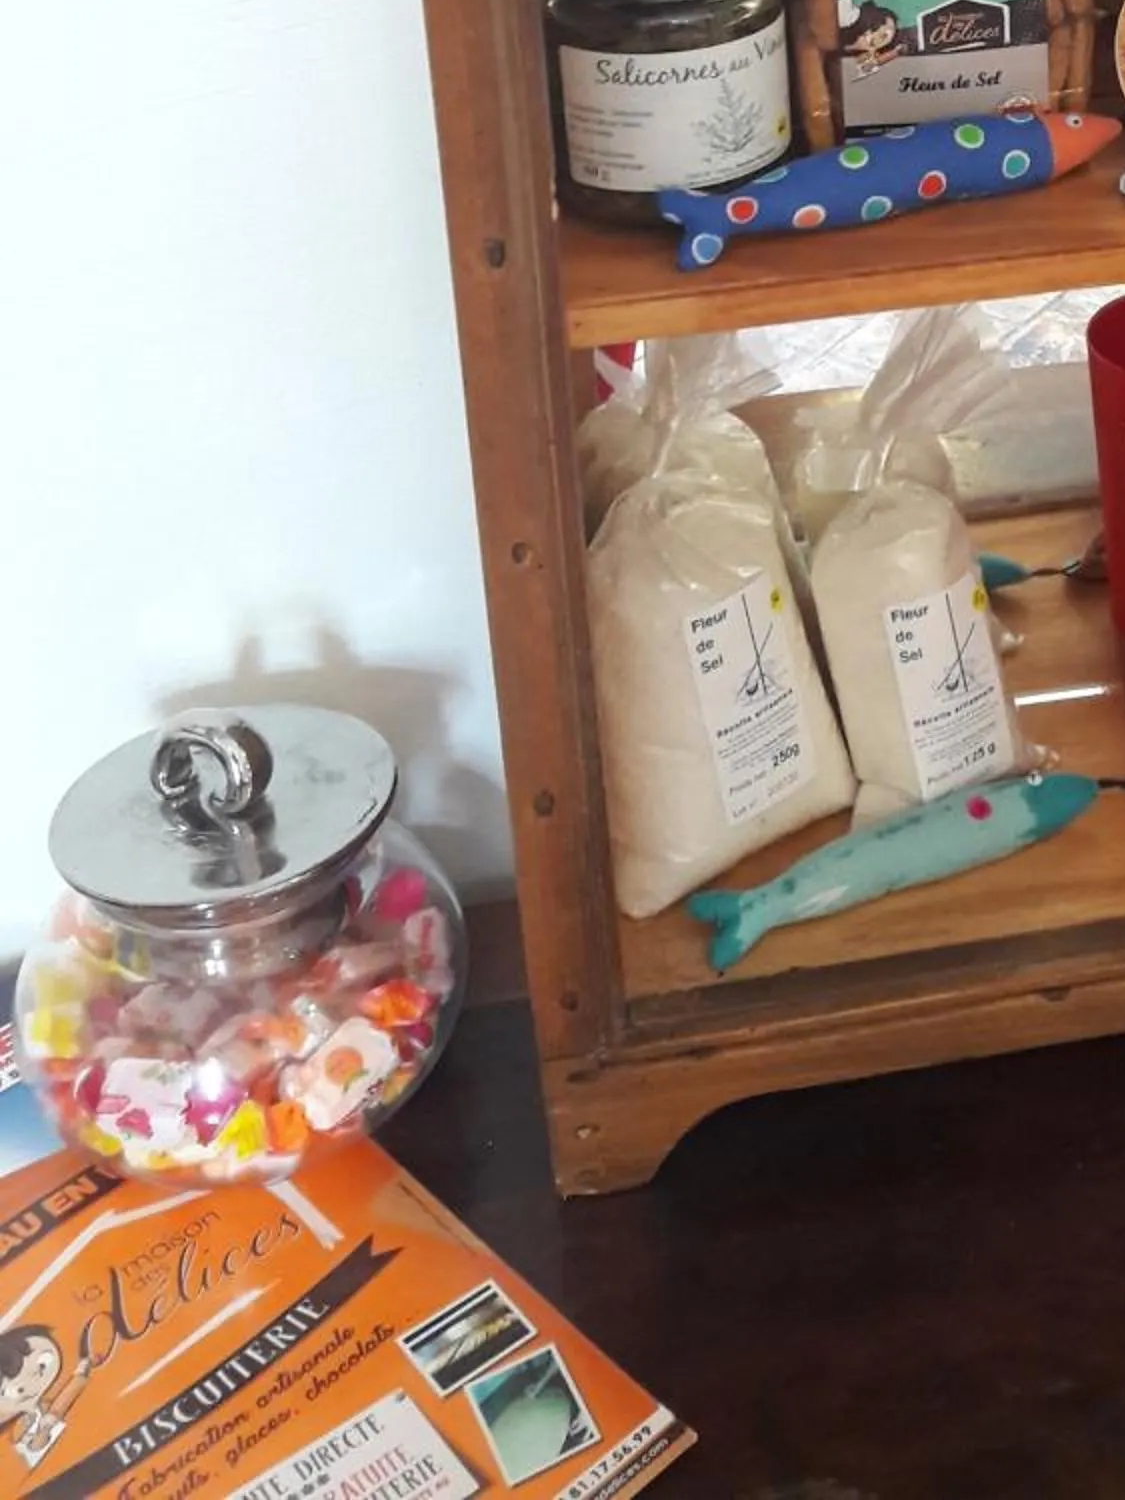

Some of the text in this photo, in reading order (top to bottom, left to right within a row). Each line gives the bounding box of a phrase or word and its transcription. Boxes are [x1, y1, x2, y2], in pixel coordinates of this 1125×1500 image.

[594, 57, 724, 87] Salicornes
[899, 70, 1003, 93] Fleur de Sel
[690, 608, 729, 635] Fleur
[890, 605, 929, 623] Fleur
[695, 638, 715, 655] de
[895, 630, 914, 644] de
[700, 653, 724, 674] Sel
[899, 648, 923, 664] Sel
[121, 1209, 222, 1278] maison
[255, 1324, 356, 1408] artisanale
[304, 1322, 397, 1401] chocolats
[111, 1296, 331, 1467] BISCUITERIE
[292, 1412, 386, 1482] DIRECTE
